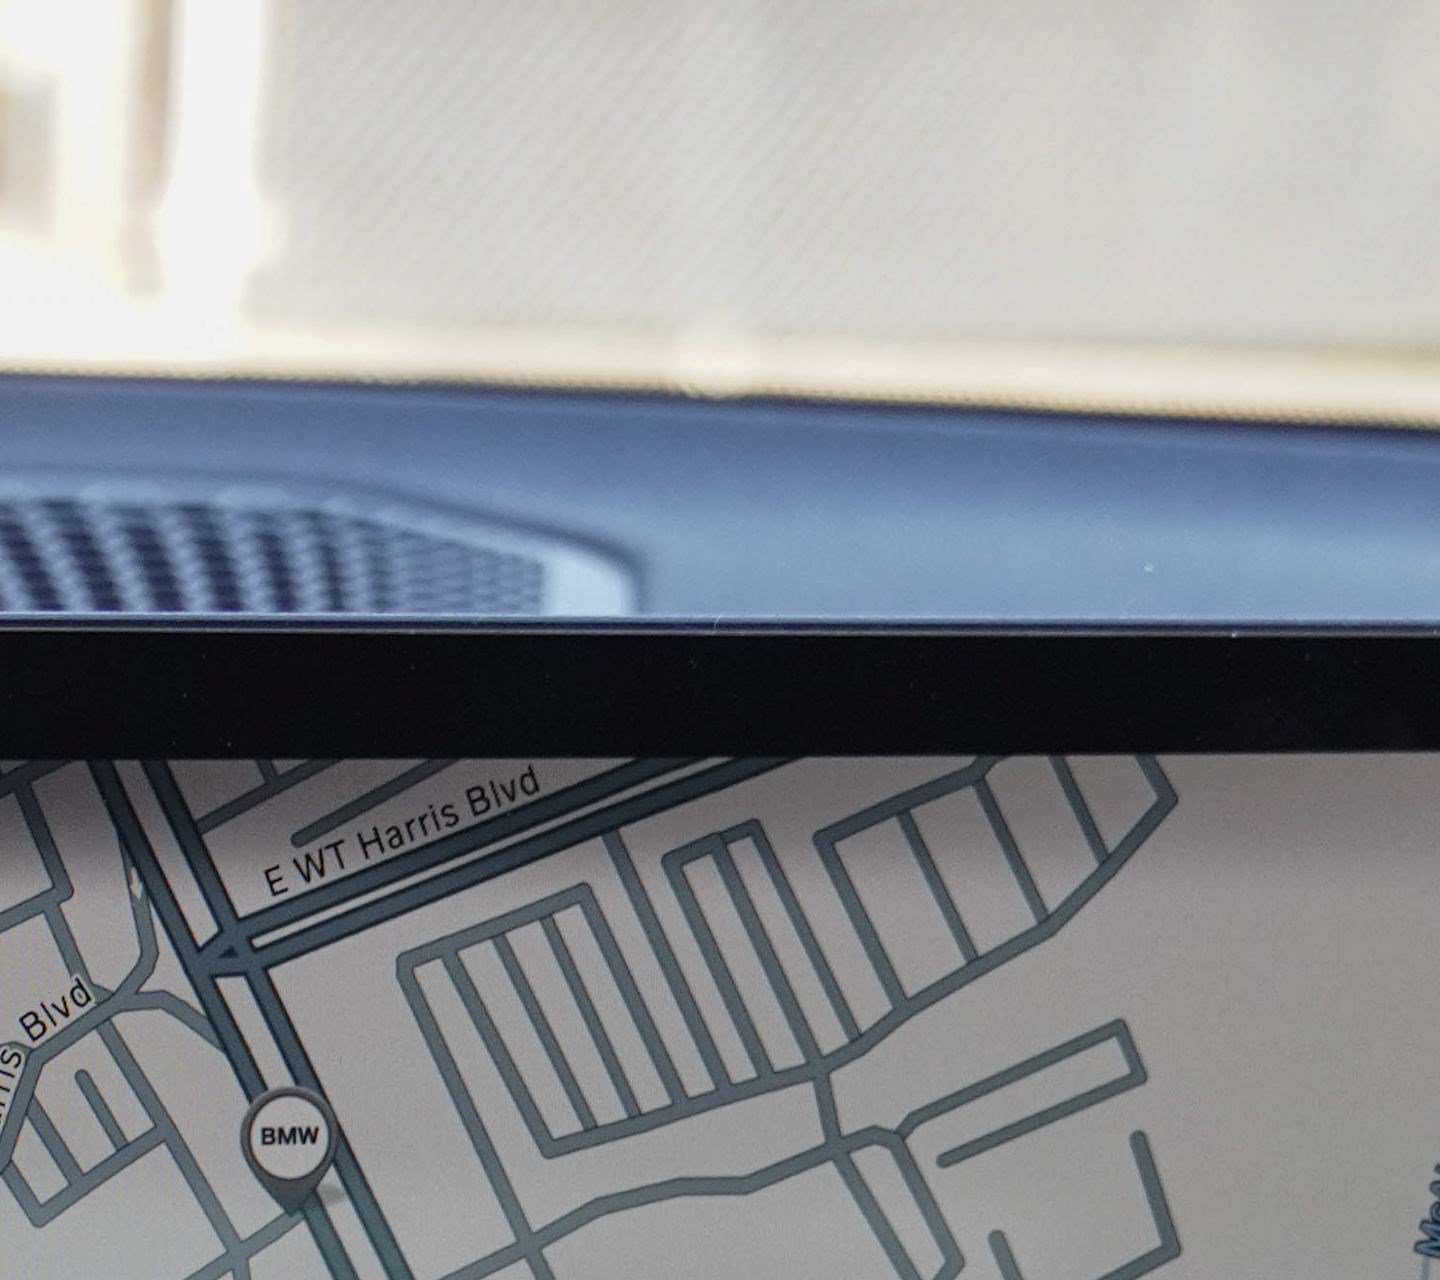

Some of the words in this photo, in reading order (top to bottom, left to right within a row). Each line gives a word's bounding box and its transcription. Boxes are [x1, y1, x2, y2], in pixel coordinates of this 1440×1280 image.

[264, 866, 288, 897] E
[295, 840, 348, 882] WT
[357, 790, 460, 860] Harris
[467, 764, 542, 818] Blvd
[20, 976, 93, 1042] Blvd
[260, 1125, 320, 1147] BMW
